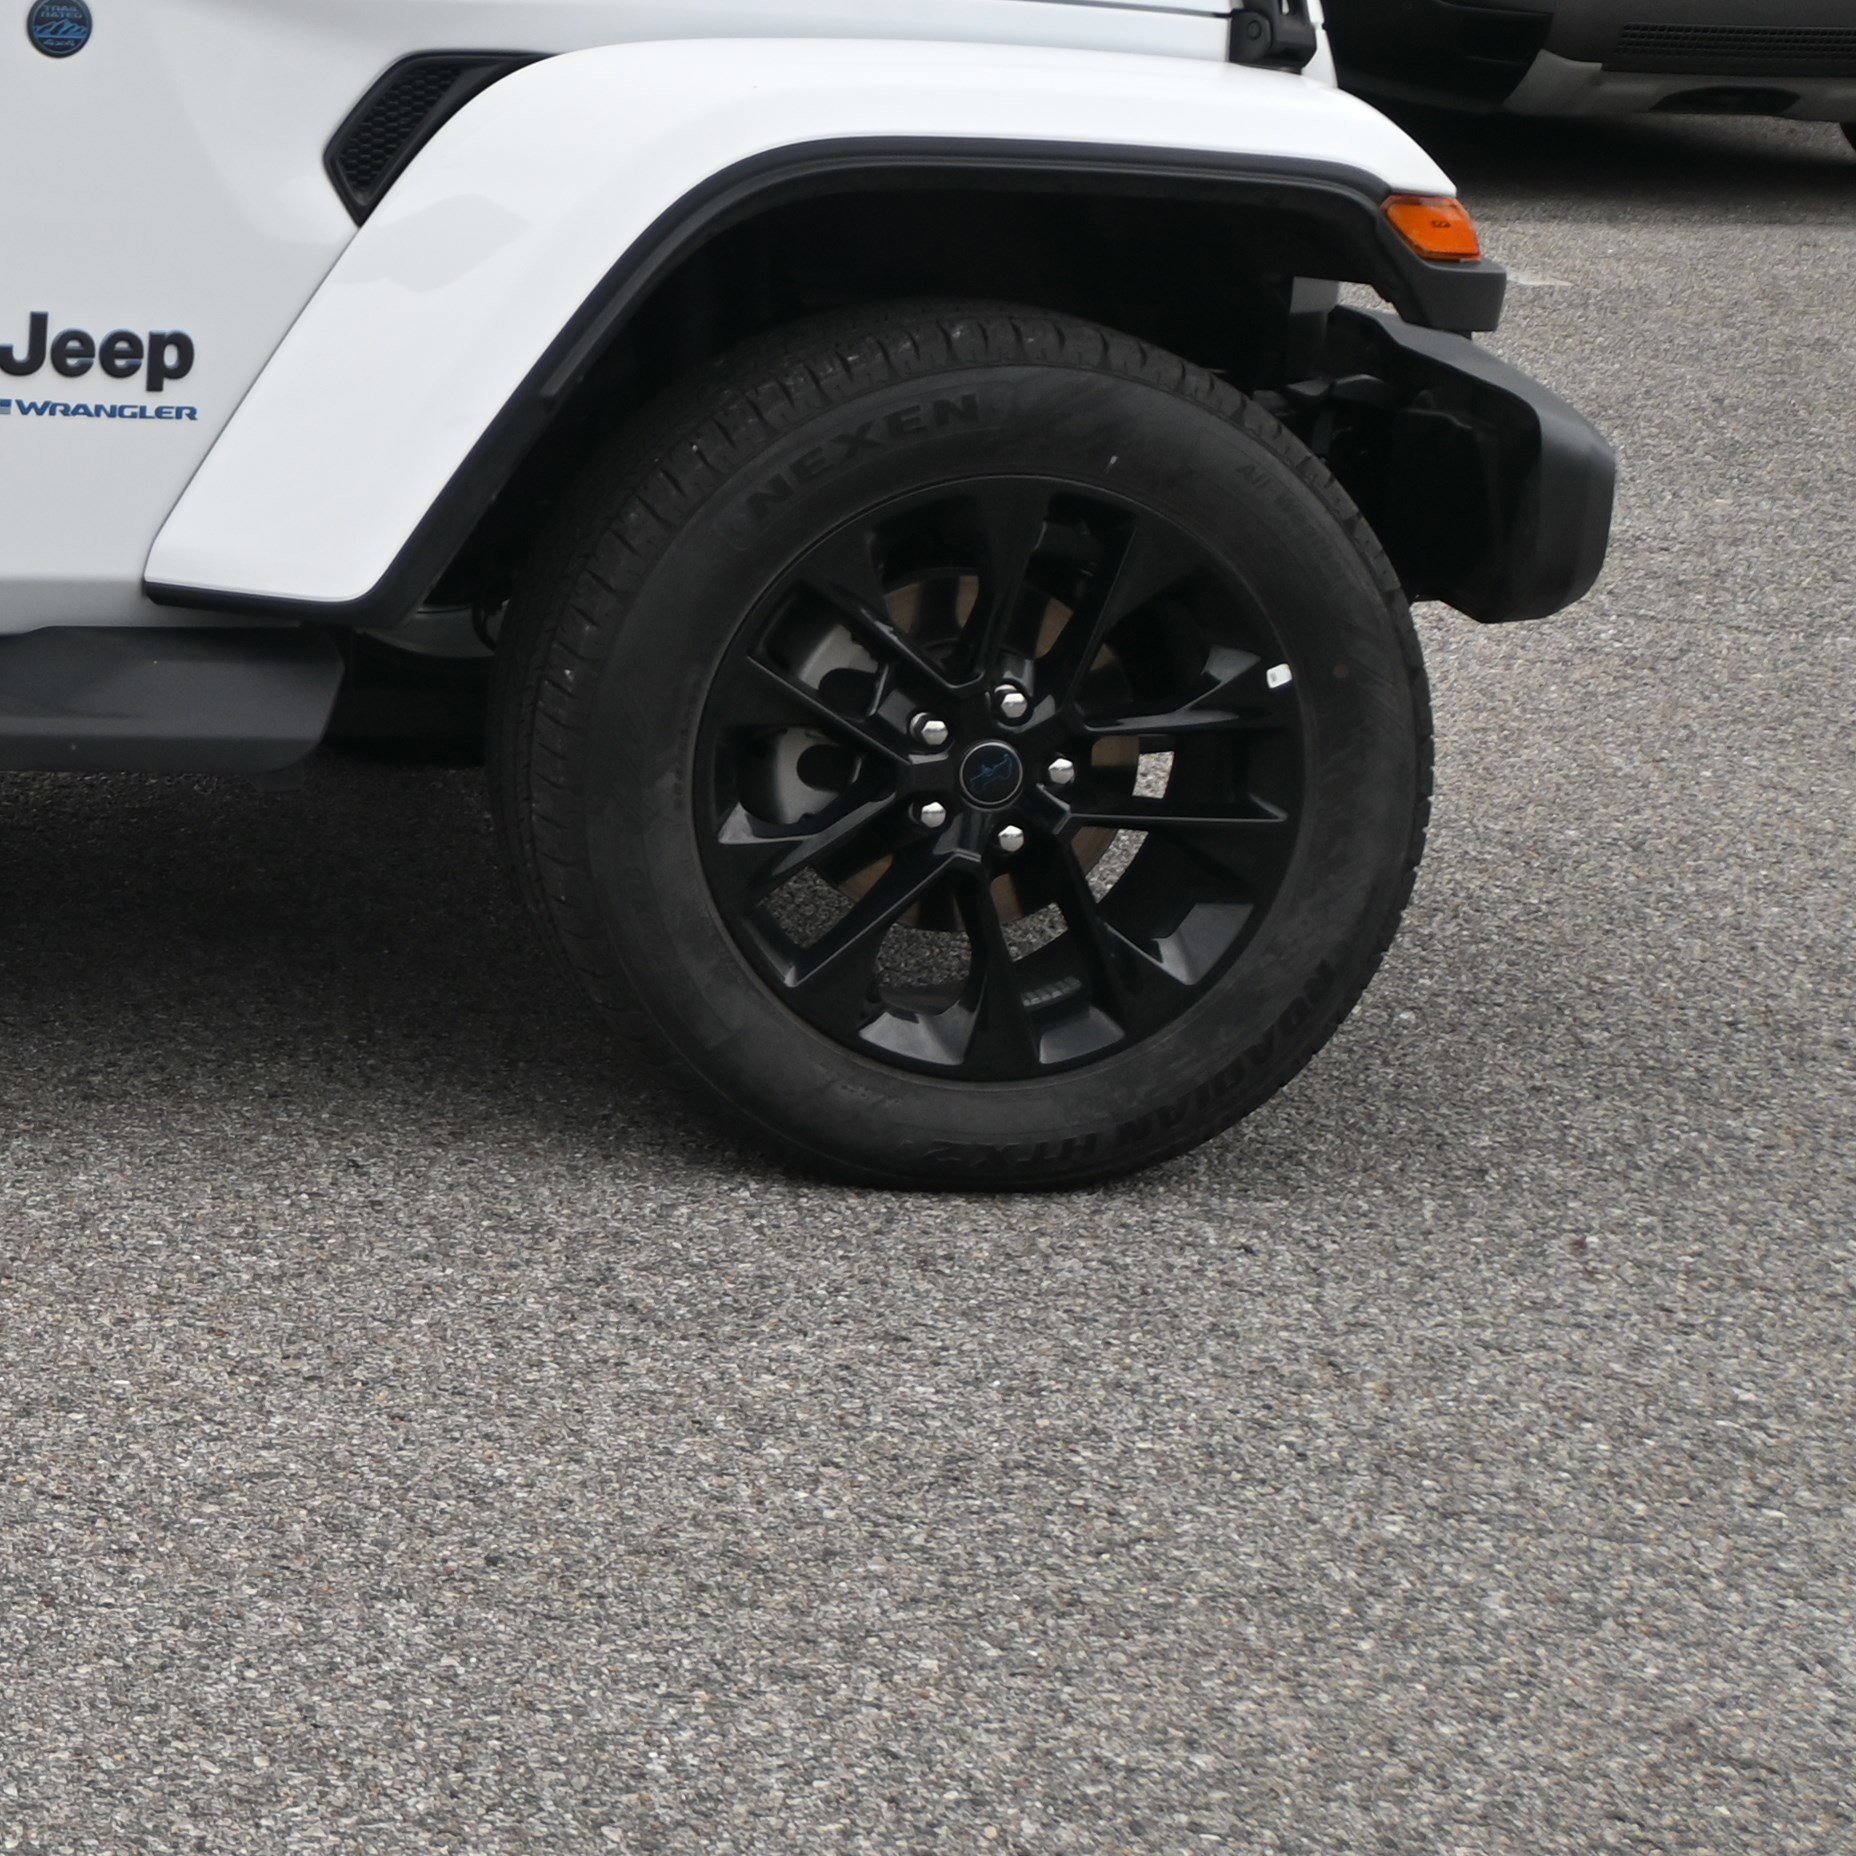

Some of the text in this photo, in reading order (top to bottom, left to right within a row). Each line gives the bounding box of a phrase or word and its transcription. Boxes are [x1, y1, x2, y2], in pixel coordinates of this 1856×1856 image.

[15, 399, 198, 420] WRANGLER
[744, 393, 980, 519] NEXEN
[1114, 958, 1342, 1149] ROADIAN
